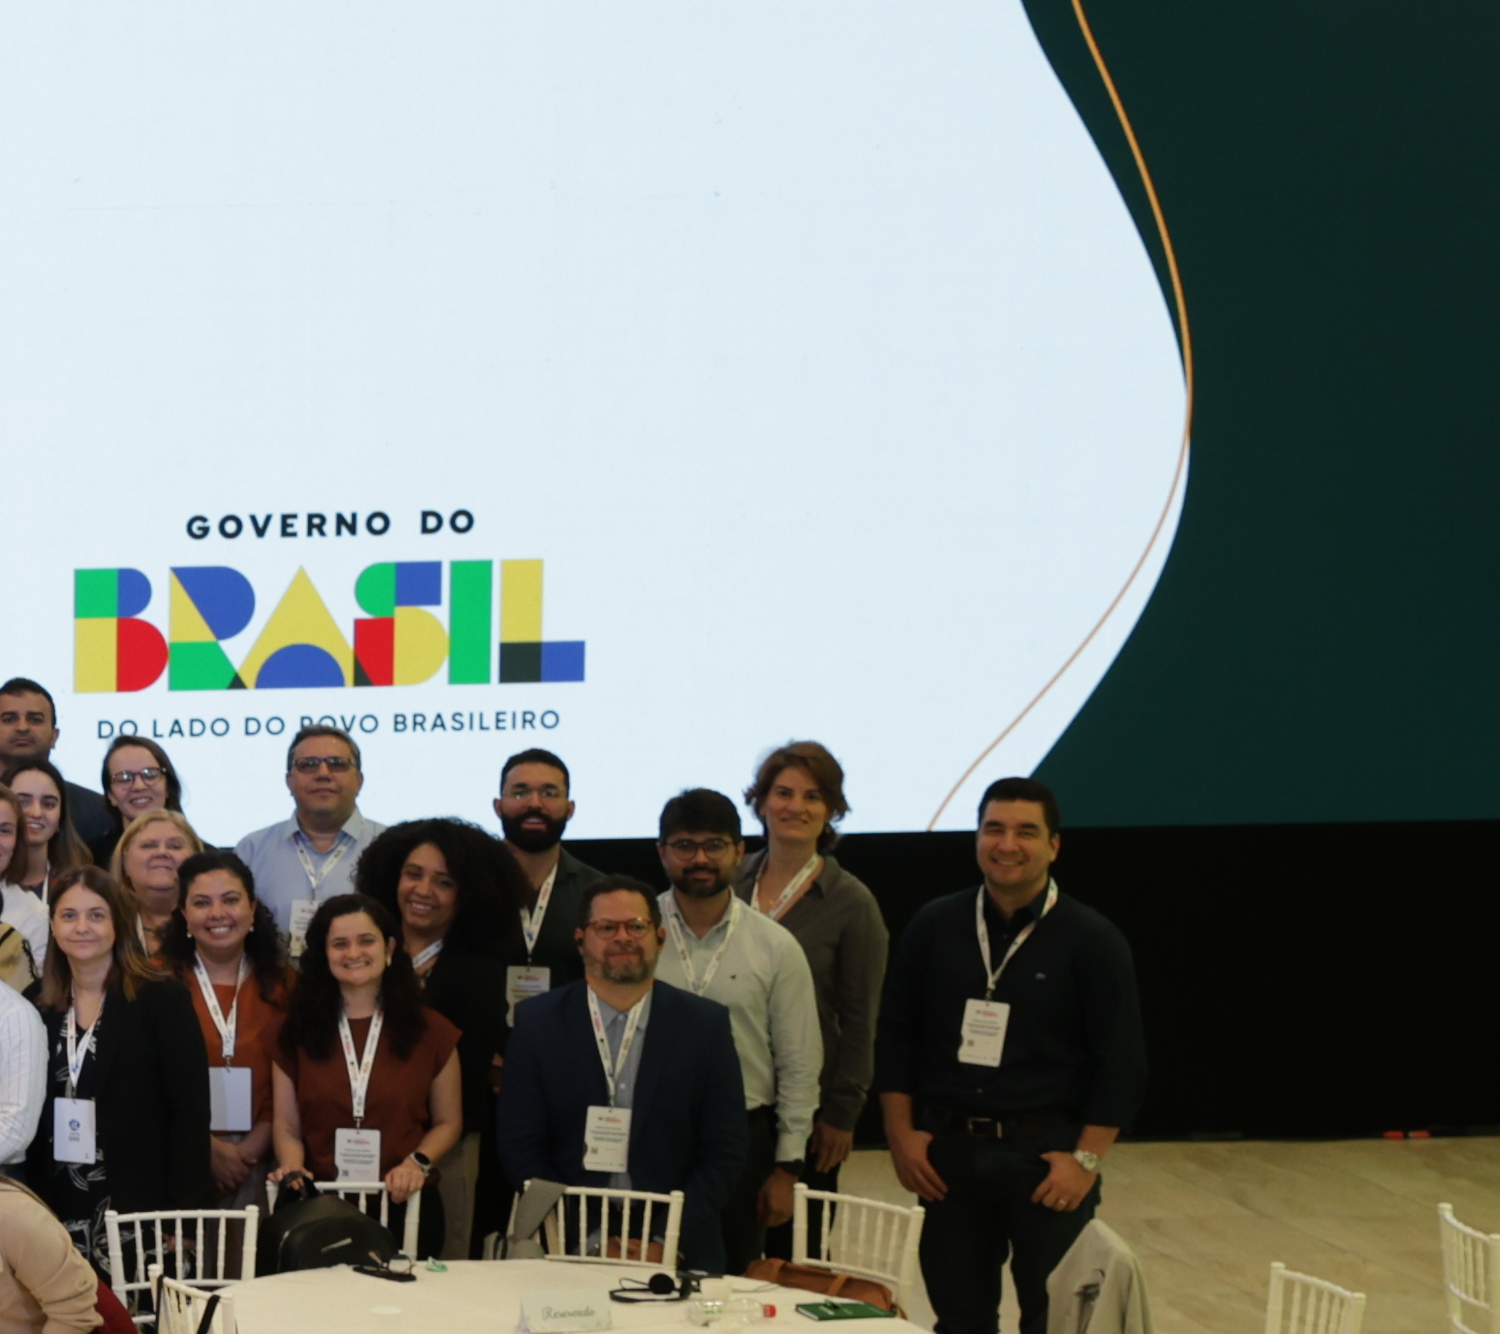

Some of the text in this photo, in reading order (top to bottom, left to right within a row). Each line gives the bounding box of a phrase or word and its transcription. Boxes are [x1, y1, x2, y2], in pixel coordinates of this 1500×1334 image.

[186, 509, 475, 540] GOVERNO DO
[74, 558, 586, 694] BRASIL
[97, 719, 138, 740] DO
[152, 717, 230, 739] LADO
[244, 716, 285, 736] DO
[393, 710, 560, 734] BRASILEIRO
